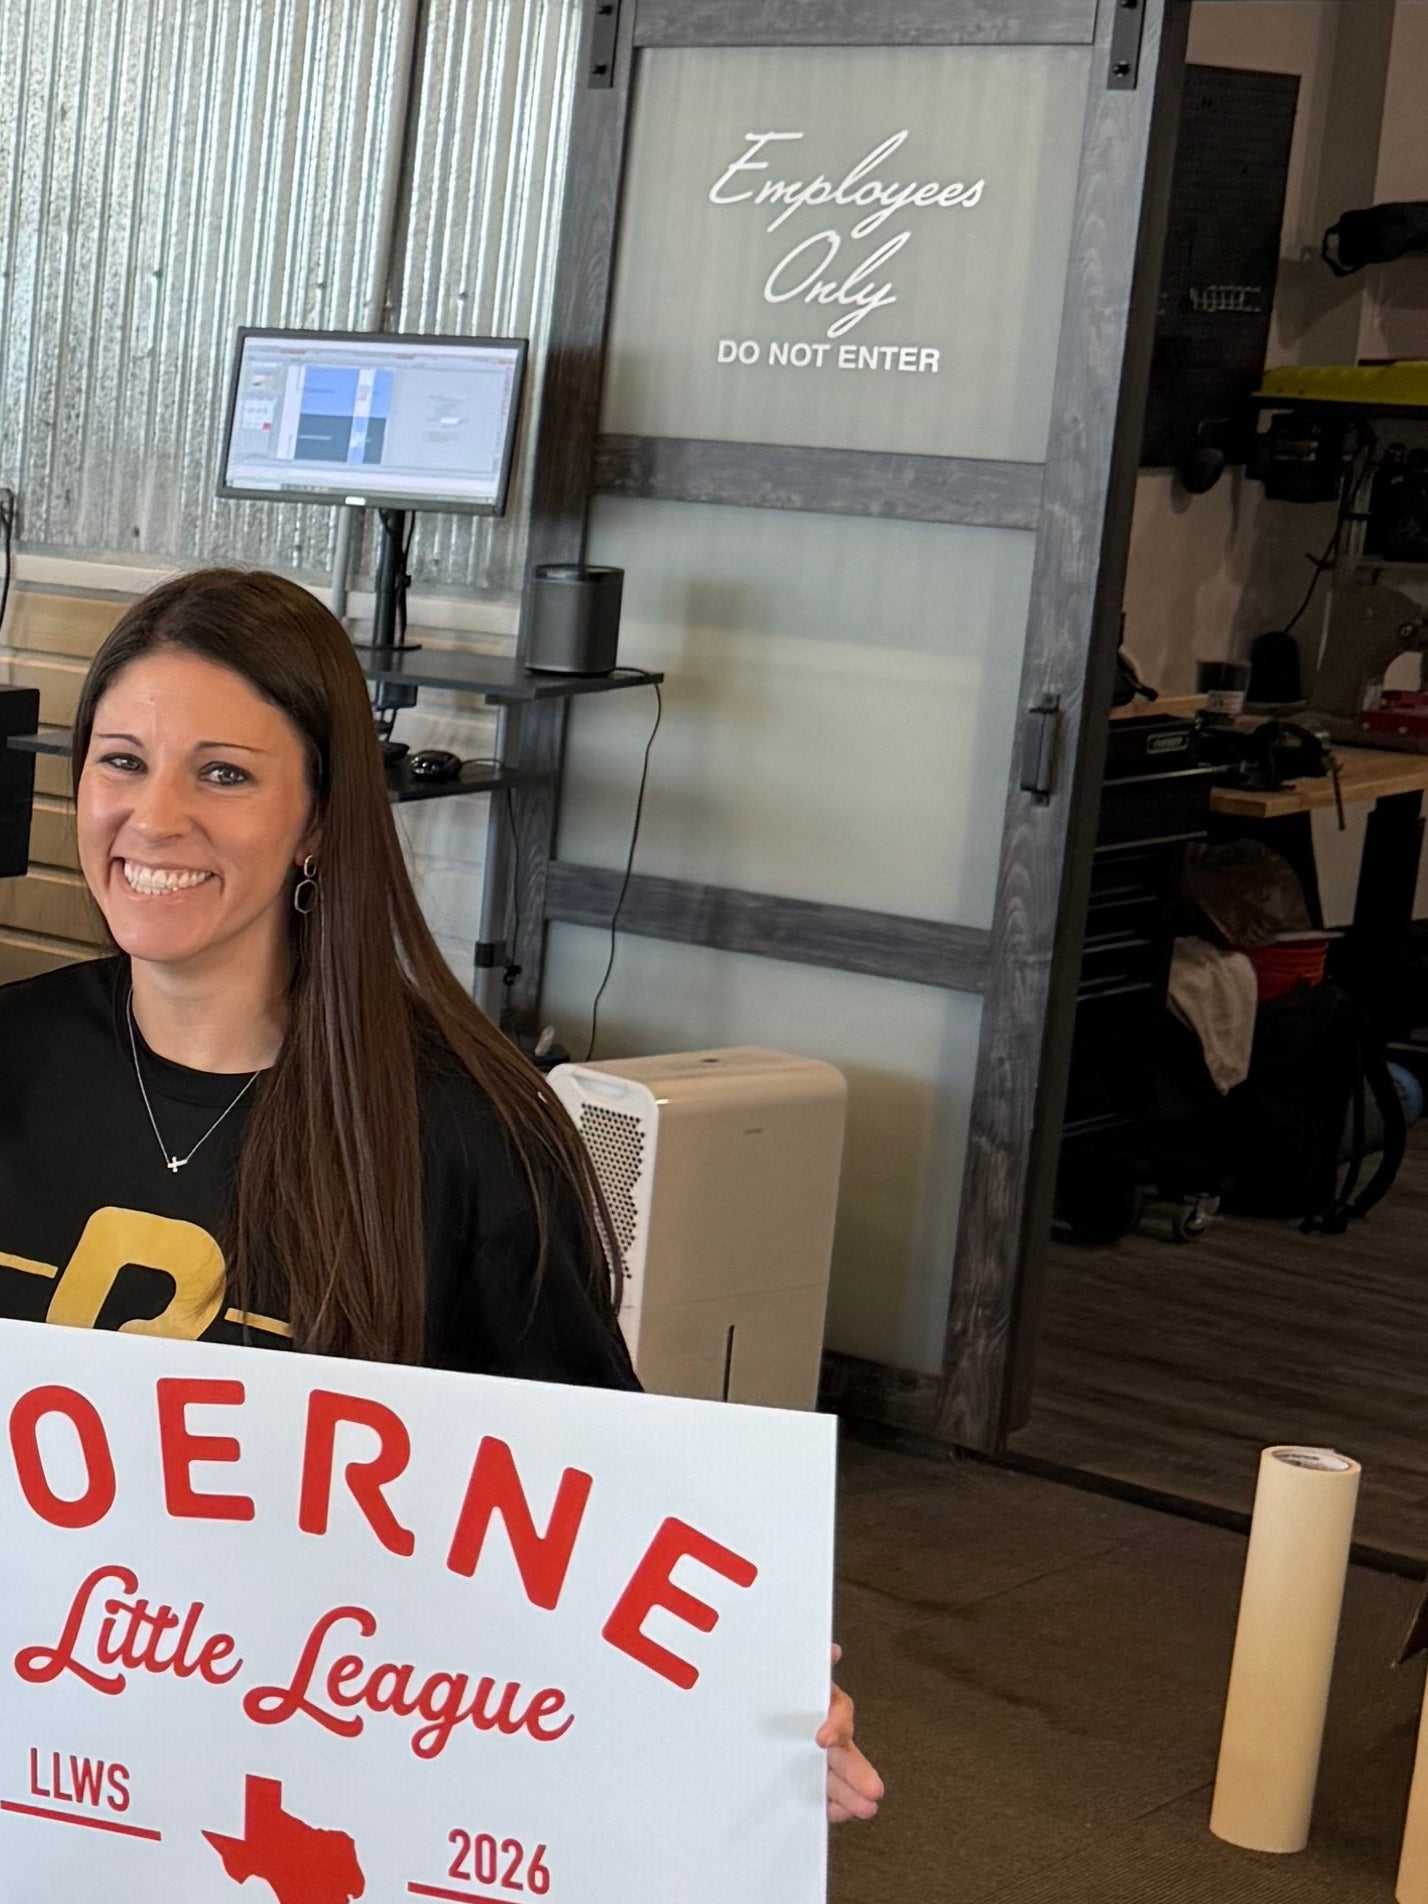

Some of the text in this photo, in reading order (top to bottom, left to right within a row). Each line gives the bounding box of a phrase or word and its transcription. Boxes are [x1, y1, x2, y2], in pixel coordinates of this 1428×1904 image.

[709, 130, 985, 239] Employees
[764, 231, 911, 339] Only
[717, 340, 940, 373] DO NOT ENTER
[14, 1566, 571, 1759] Little League
[29, 1748, 131, 1814] LLWS
[447, 1826, 551, 1897] 2026
